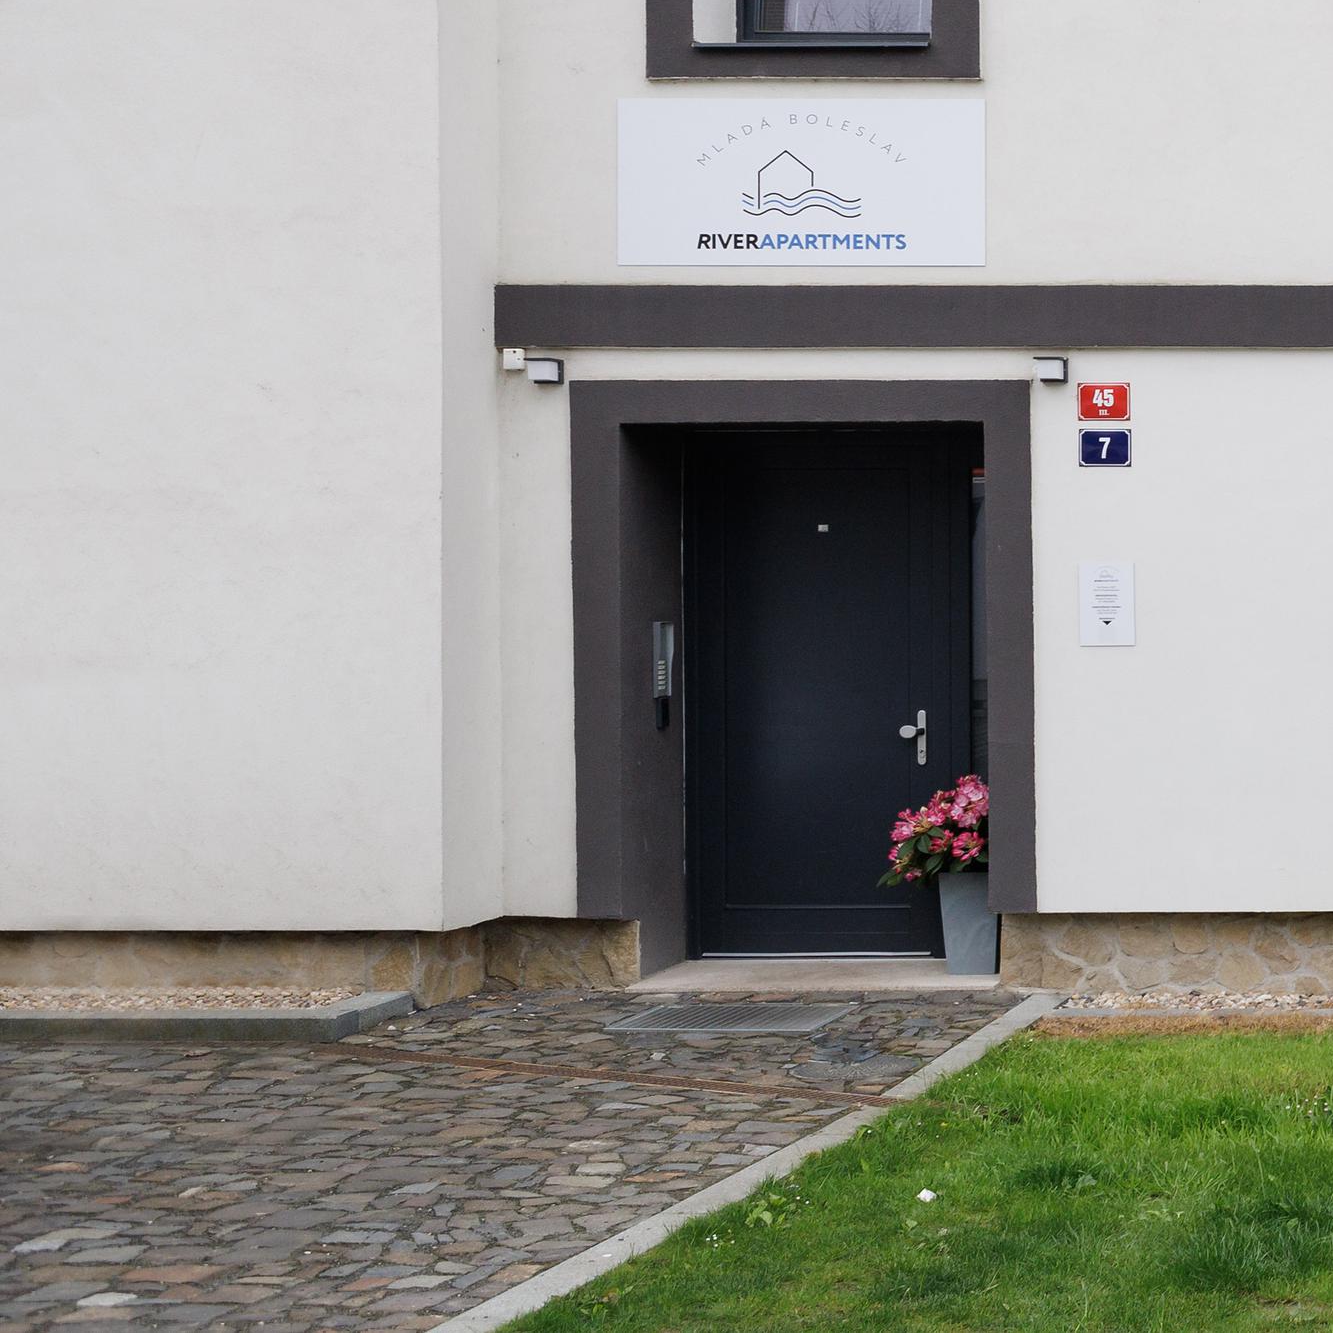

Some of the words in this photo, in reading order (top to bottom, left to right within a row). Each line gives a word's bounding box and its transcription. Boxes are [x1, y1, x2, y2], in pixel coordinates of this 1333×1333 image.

[789, 113, 908, 163] BOLESLAV
[697, 233, 907, 250] RIVERAPARTMENTS
[1092, 388, 1115, 407] 45
[1098, 436, 1111, 459] 7
